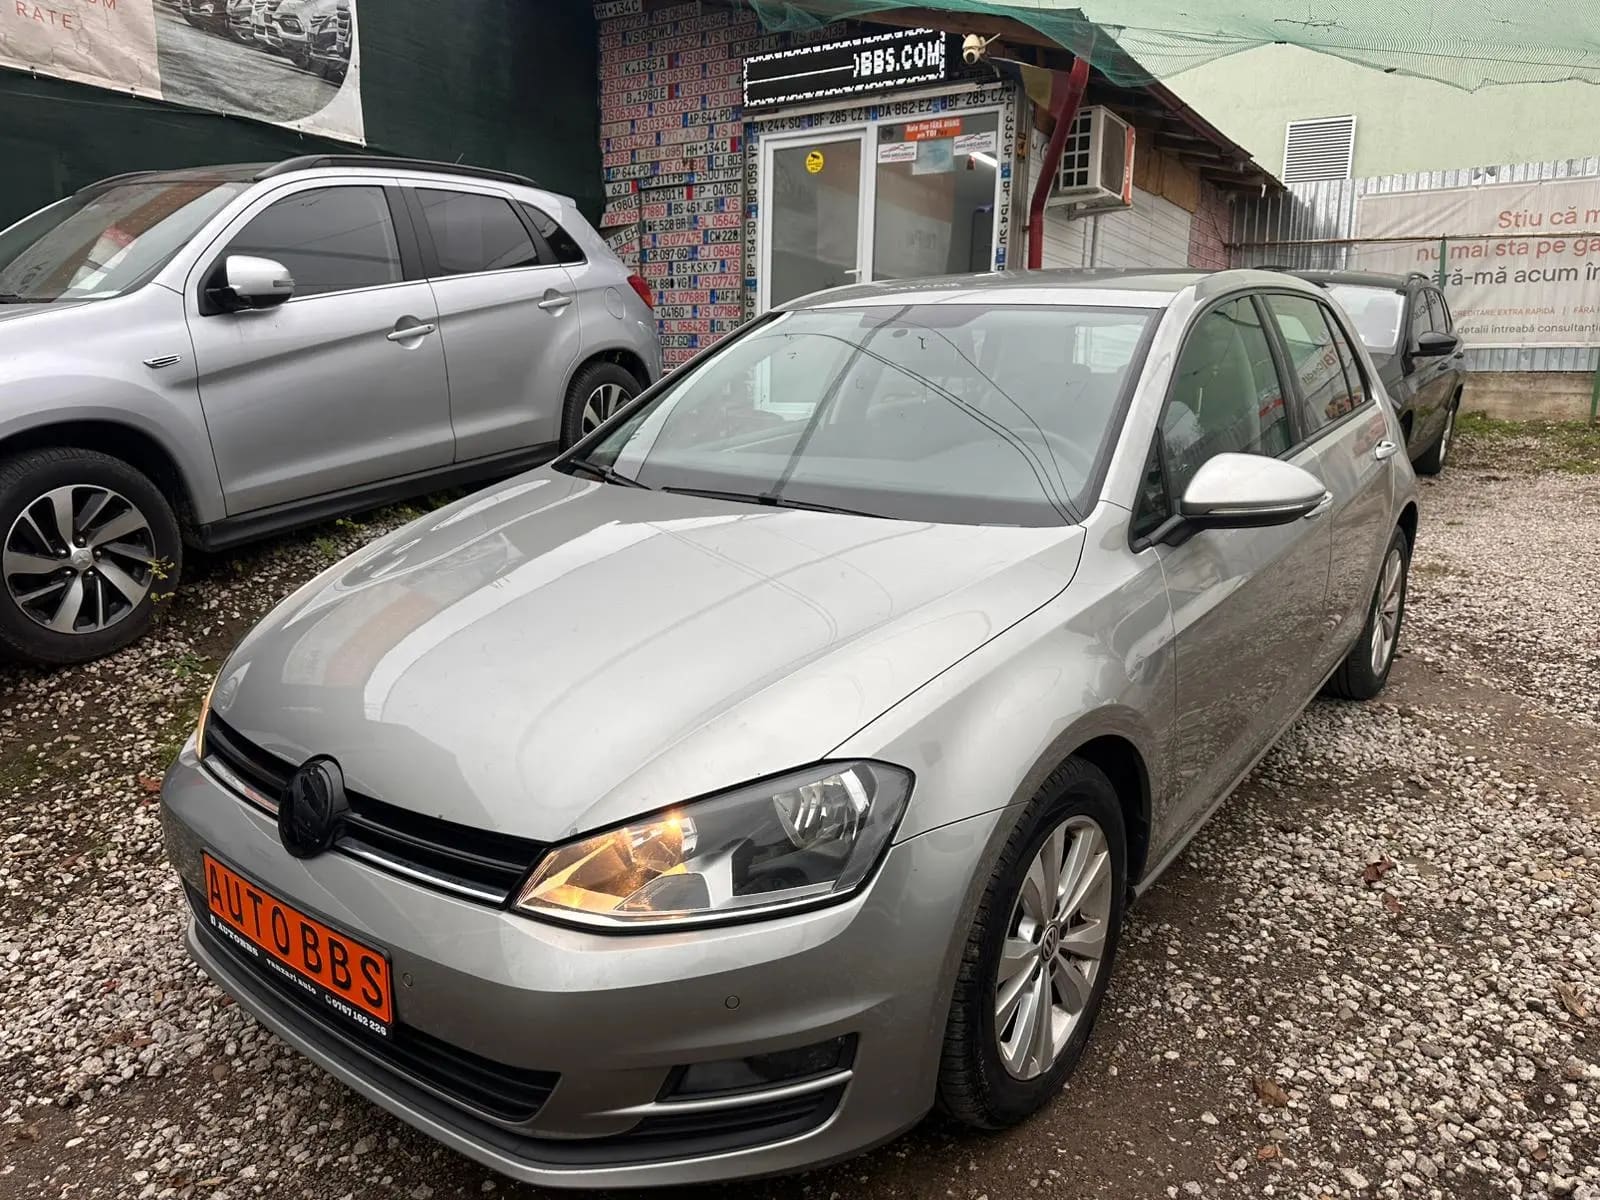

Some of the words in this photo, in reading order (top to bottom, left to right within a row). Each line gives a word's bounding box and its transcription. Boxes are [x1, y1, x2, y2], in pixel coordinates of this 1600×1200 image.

[15, 0, 73, 29] RATE
[1450, 239, 1489, 259] mai
[1495, 239, 1530, 258] sta
[1536, 239, 1567, 260] pe
[1513, 267, 1579, 283] acum
